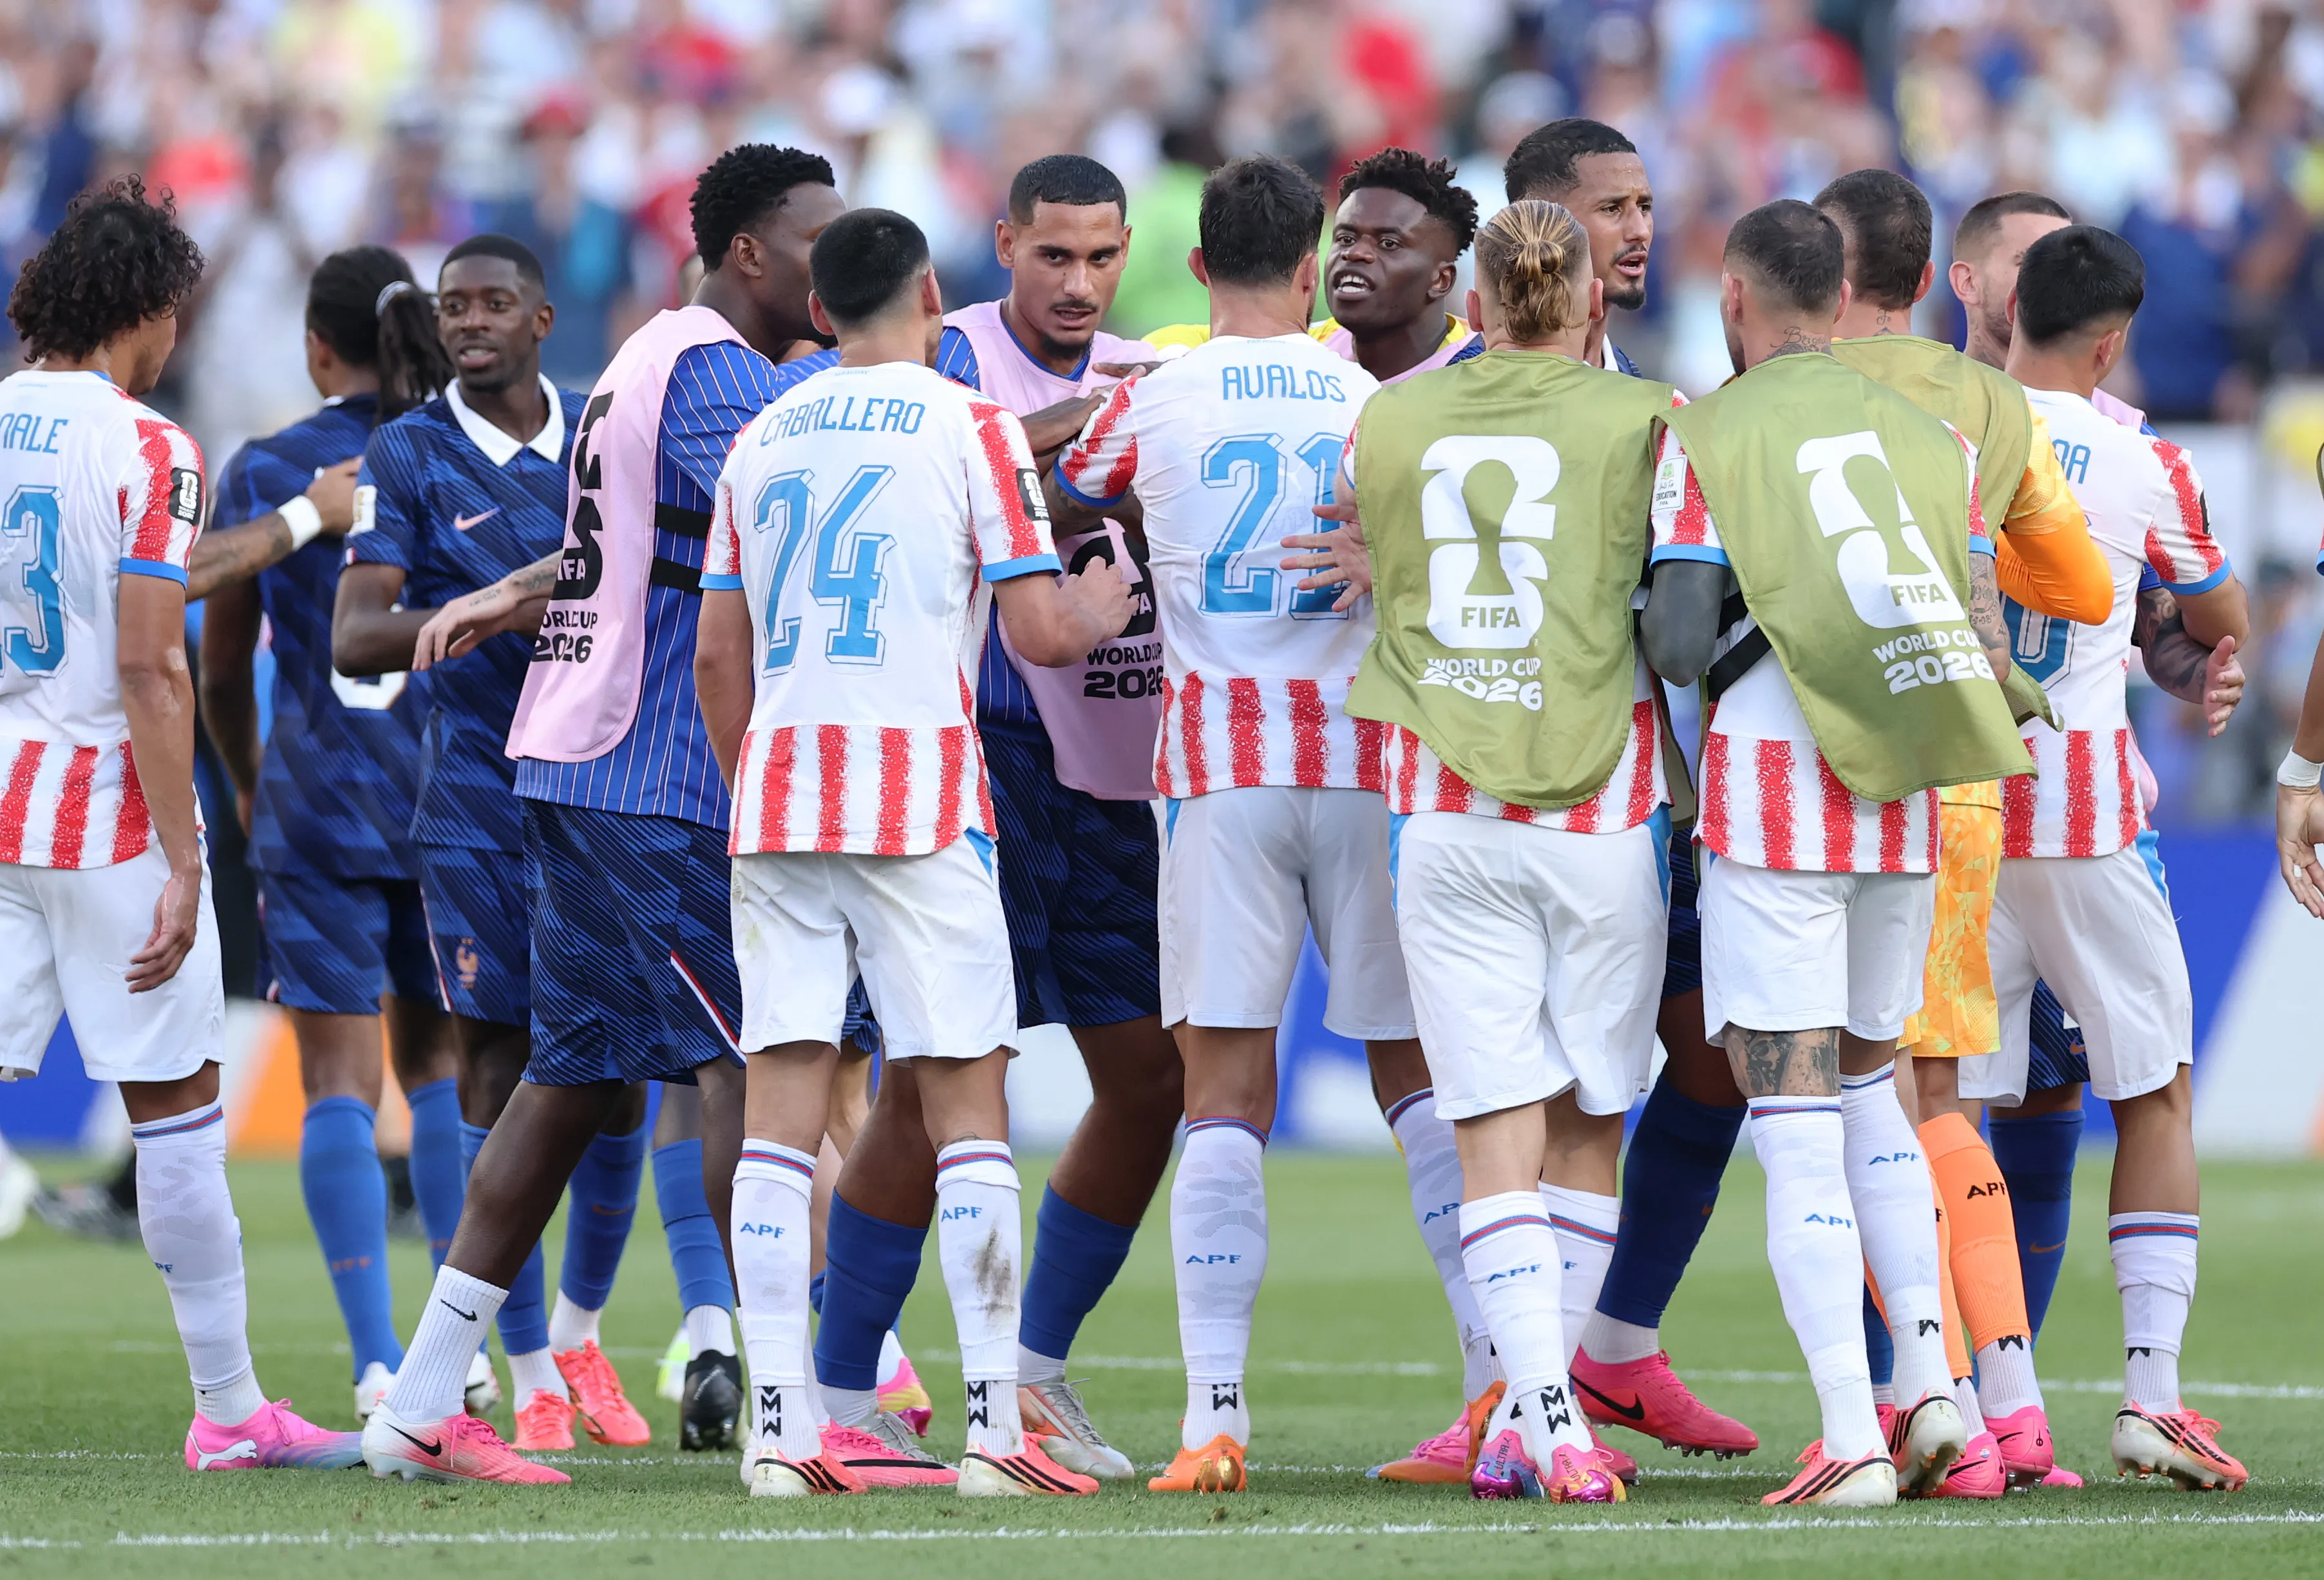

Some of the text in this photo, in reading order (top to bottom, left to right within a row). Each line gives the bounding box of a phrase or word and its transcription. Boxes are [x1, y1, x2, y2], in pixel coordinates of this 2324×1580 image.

[1222, 365, 1346, 403] AVALOS
[760, 396, 925, 447] CABALLERO
[1198, 432, 1350, 620] 21
[558, 558, 586, 581] IFA
[754, 464, 897, 678] 24
[0, 485, 68, 678] 3
[1891, 583, 1949, 607] FIFA
[543, 610, 571, 629] ORL
[1461, 607, 1521, 628] FIFA
[531, 633, 593, 663] 2026
[1087, 646, 1151, 665] WORLD
[1872, 631, 1951, 663] WORLD
[1427, 657, 1542, 676] WORLD CUP
[1884, 651, 1996, 695] 2026
[1084, 665, 1164, 700] 2026
[1417, 667, 1542, 711] 2026
[1868, 1152, 1920, 1166] APF
[941, 1206, 983, 1223] APF
[1424, 1203, 1460, 1224] AP
[1804, 1214, 1853, 1229] APF
[740, 1222, 785, 1239] APF
[155, 1262, 173, 1273] PF
[1186, 1254, 1242, 1264] APF
[1488, 1264, 1542, 1283] APF
[1494, 1445, 1510, 1470] ULTRA
[1562, 1458, 1581, 1481] ULTRA
